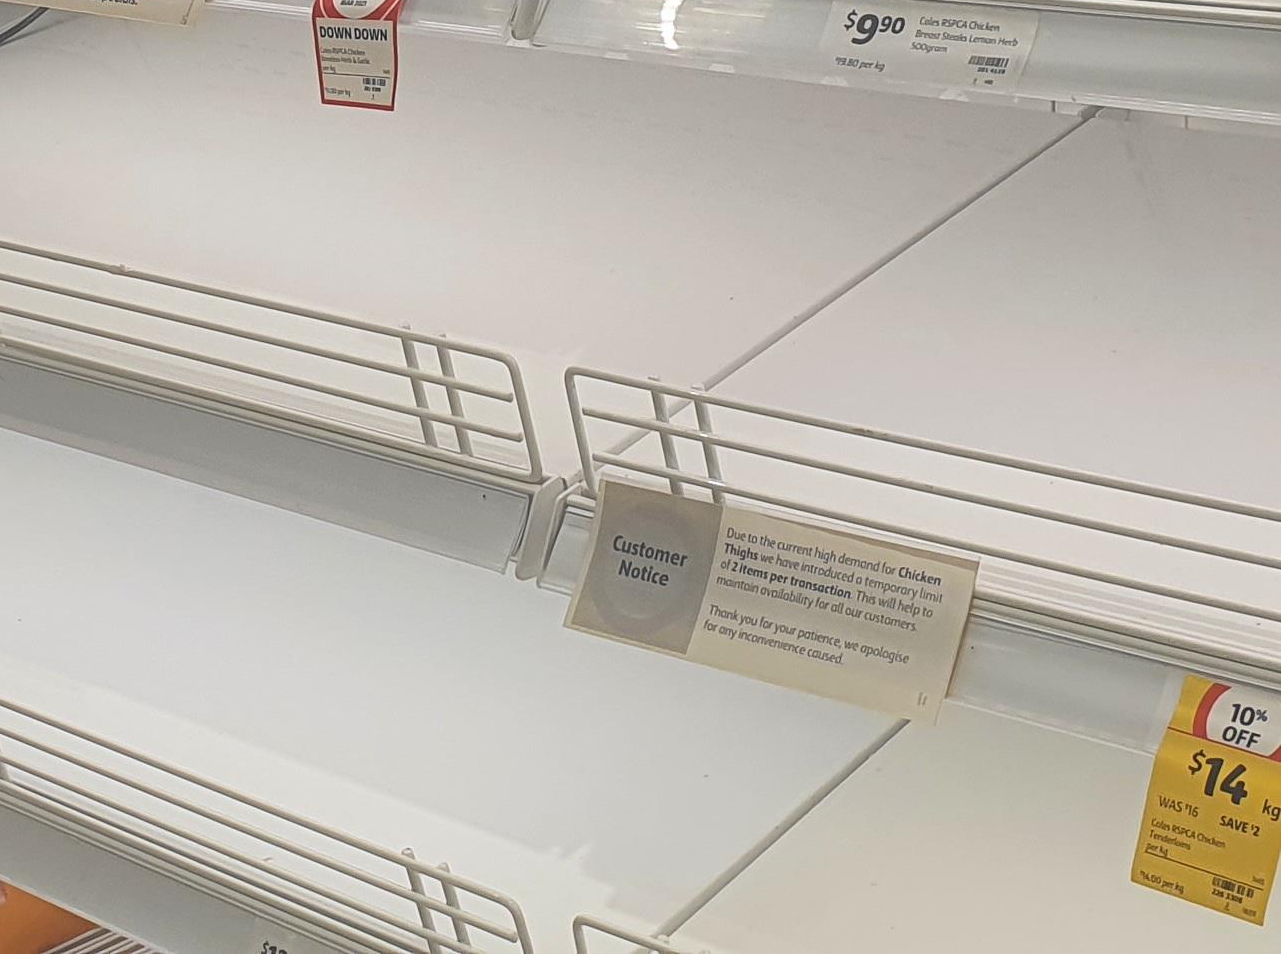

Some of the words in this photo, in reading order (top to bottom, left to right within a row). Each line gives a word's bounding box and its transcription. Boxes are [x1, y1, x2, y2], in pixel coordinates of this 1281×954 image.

[319, 26, 351, 40] DOWN
[354, 27, 388, 42] DOWN
[915, 29, 941, 40] Breast
[941, 32, 967, 43] Steaks
[968, 34, 997, 45] Lemon
[997, 37, 1019, 47] Herb
[919, 16, 939, 27] Coles
[941, 18, 968, 29] RSPCA
[968, 20, 1000, 32] Chicken
[612, 534, 688, 568] Customer
[726, 526, 746, 542] Due
[747, 533, 758, 544] to
[759, 534, 776, 549] the
[776, 541, 813, 557] current
[813, 546, 837, 564] high
[837, 552, 881, 572] demand
[880, 560, 896, 575] for
[897, 566, 942, 586] Chicken
[618, 558, 670, 587] Notice
[724, 541, 759, 561] Thighs
[760, 553, 774, 564] we
[774, 553, 800, 571] have
[800, 561, 855, 583] introduced
[855, 576, 863, 585] a
[864, 576, 918, 601] temporary
[918, 586, 943, 604] limit
[715, 575, 759, 594] maintain
[759, 586, 814, 610] availability
[814, 596, 830, 610] for
[830, 601, 845, 615] all
[844, 606, 864, 619] our
[720, 558, 731, 570] of
[730, 560, 738, 572] 2
[738, 562, 769, 580] items
[768, 572, 789, 584] per
[856, 589, 876, 605] This
[878, 597, 896, 609] will
[896, 599, 920, 618] help
[922, 606, 933, 618] to
[703, 618, 718, 632] for
[718, 625, 738, 640] any
[737, 628, 806, 655] inconvenience
[708, 603, 739, 621] Thank
[737, 614, 758, 626] you
[758, 615, 774, 629] for
[772, 622, 797, 635] your
[796, 629, 842, 650] patience,
[843, 639, 859, 652] we
[859, 644, 909, 664] apologise
[1231, 703, 1268, 726] 10%
[1221, 725, 1261, 748] OFF
[1188, 749, 1248, 806] $14
[1158, 795, 1183, 813] WAS
[1262, 798, 1281, 822] kg
[1151, 818, 1171, 832] Coles
[1171, 825, 1196, 839] RSPCA
[1197, 832, 1226, 849] Chicken
[1219, 815, 1249, 834] SAVE
